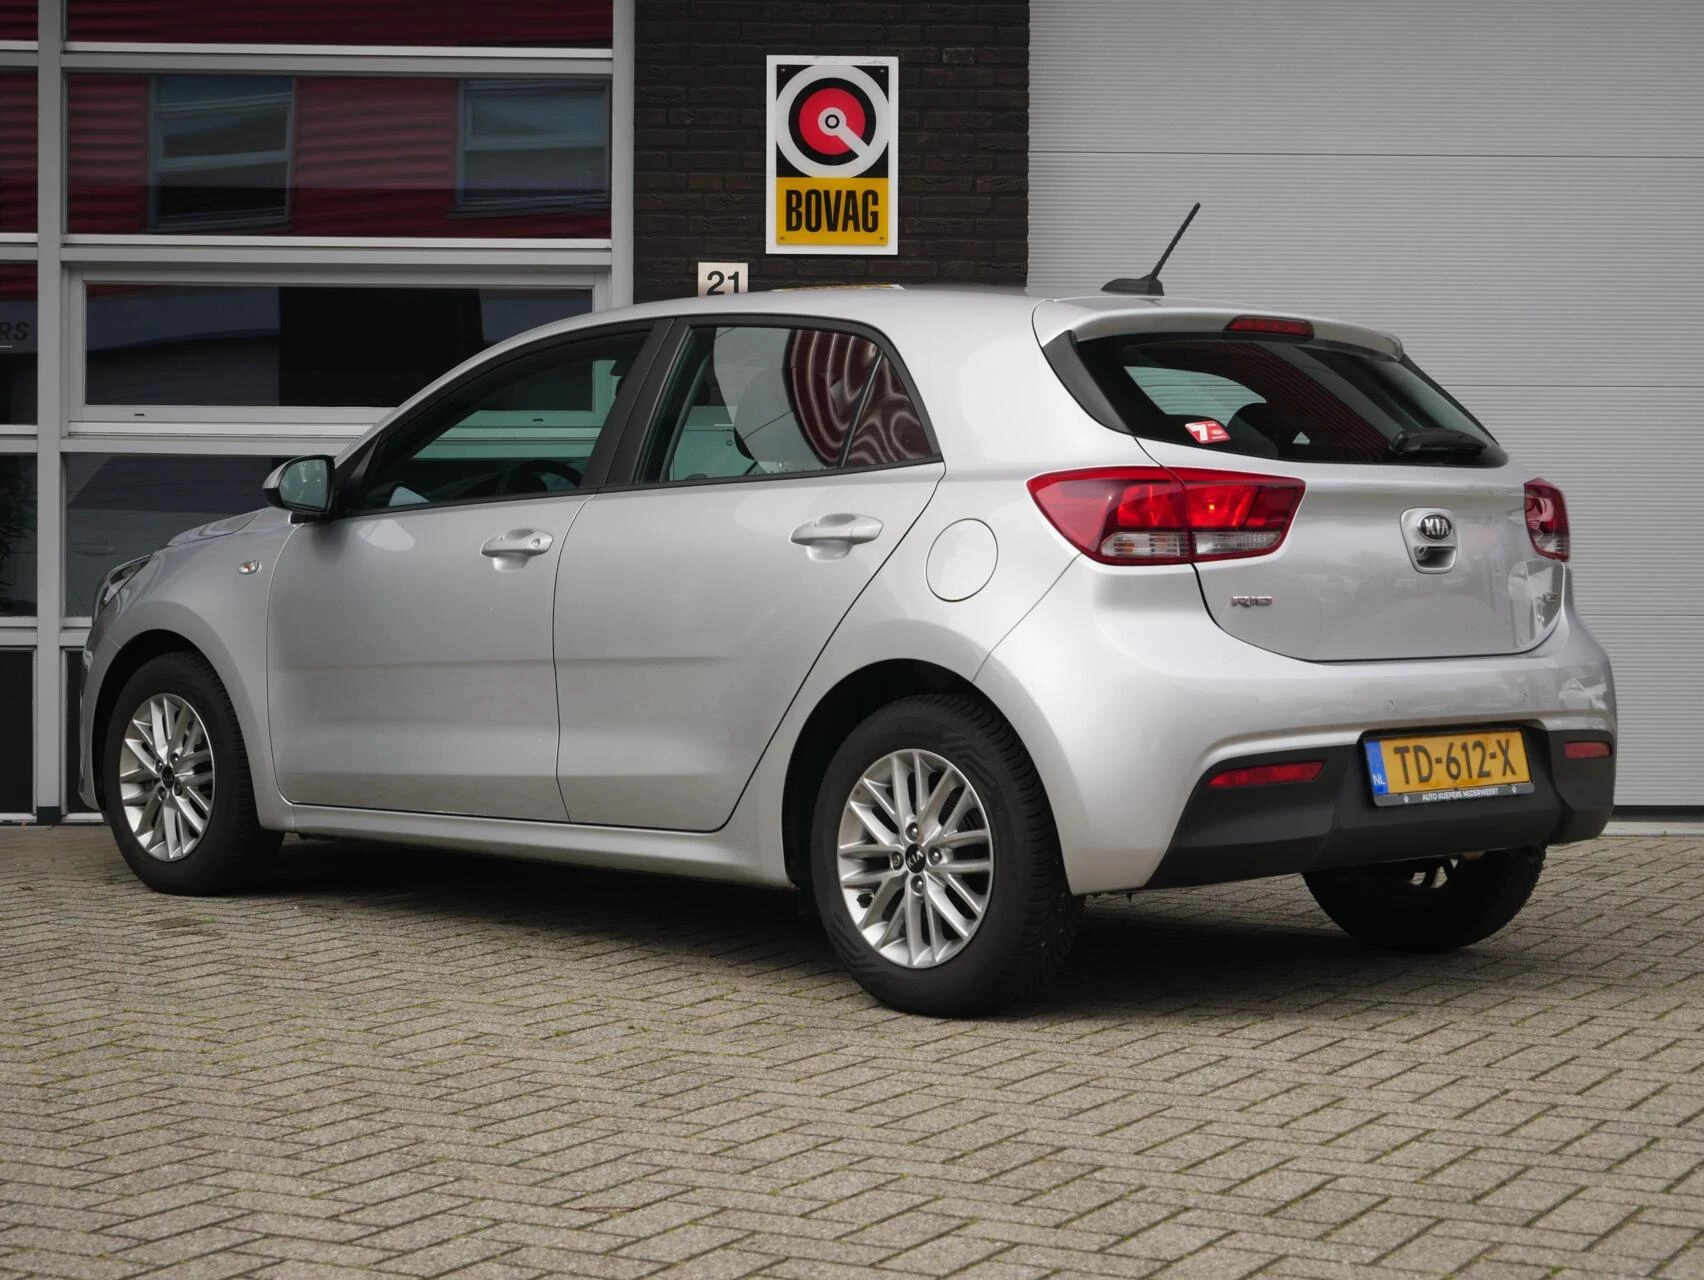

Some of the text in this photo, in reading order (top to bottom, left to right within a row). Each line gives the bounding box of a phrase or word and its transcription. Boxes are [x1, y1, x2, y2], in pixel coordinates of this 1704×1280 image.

[785, 189, 879, 233] BOVAG
[706, 270, 741, 296] 21
[1424, 518, 1450, 536] KIA
[1231, 595, 1273, 608] RIO
[1393, 738, 1517, 785] TD-612-X
[1372, 773, 1386, 786] NL
[1422, 792, 1438, 801] AUTO
[1462, 787, 1499, 798] NEDERWEERT
[907, 850, 925, 868] KIA
